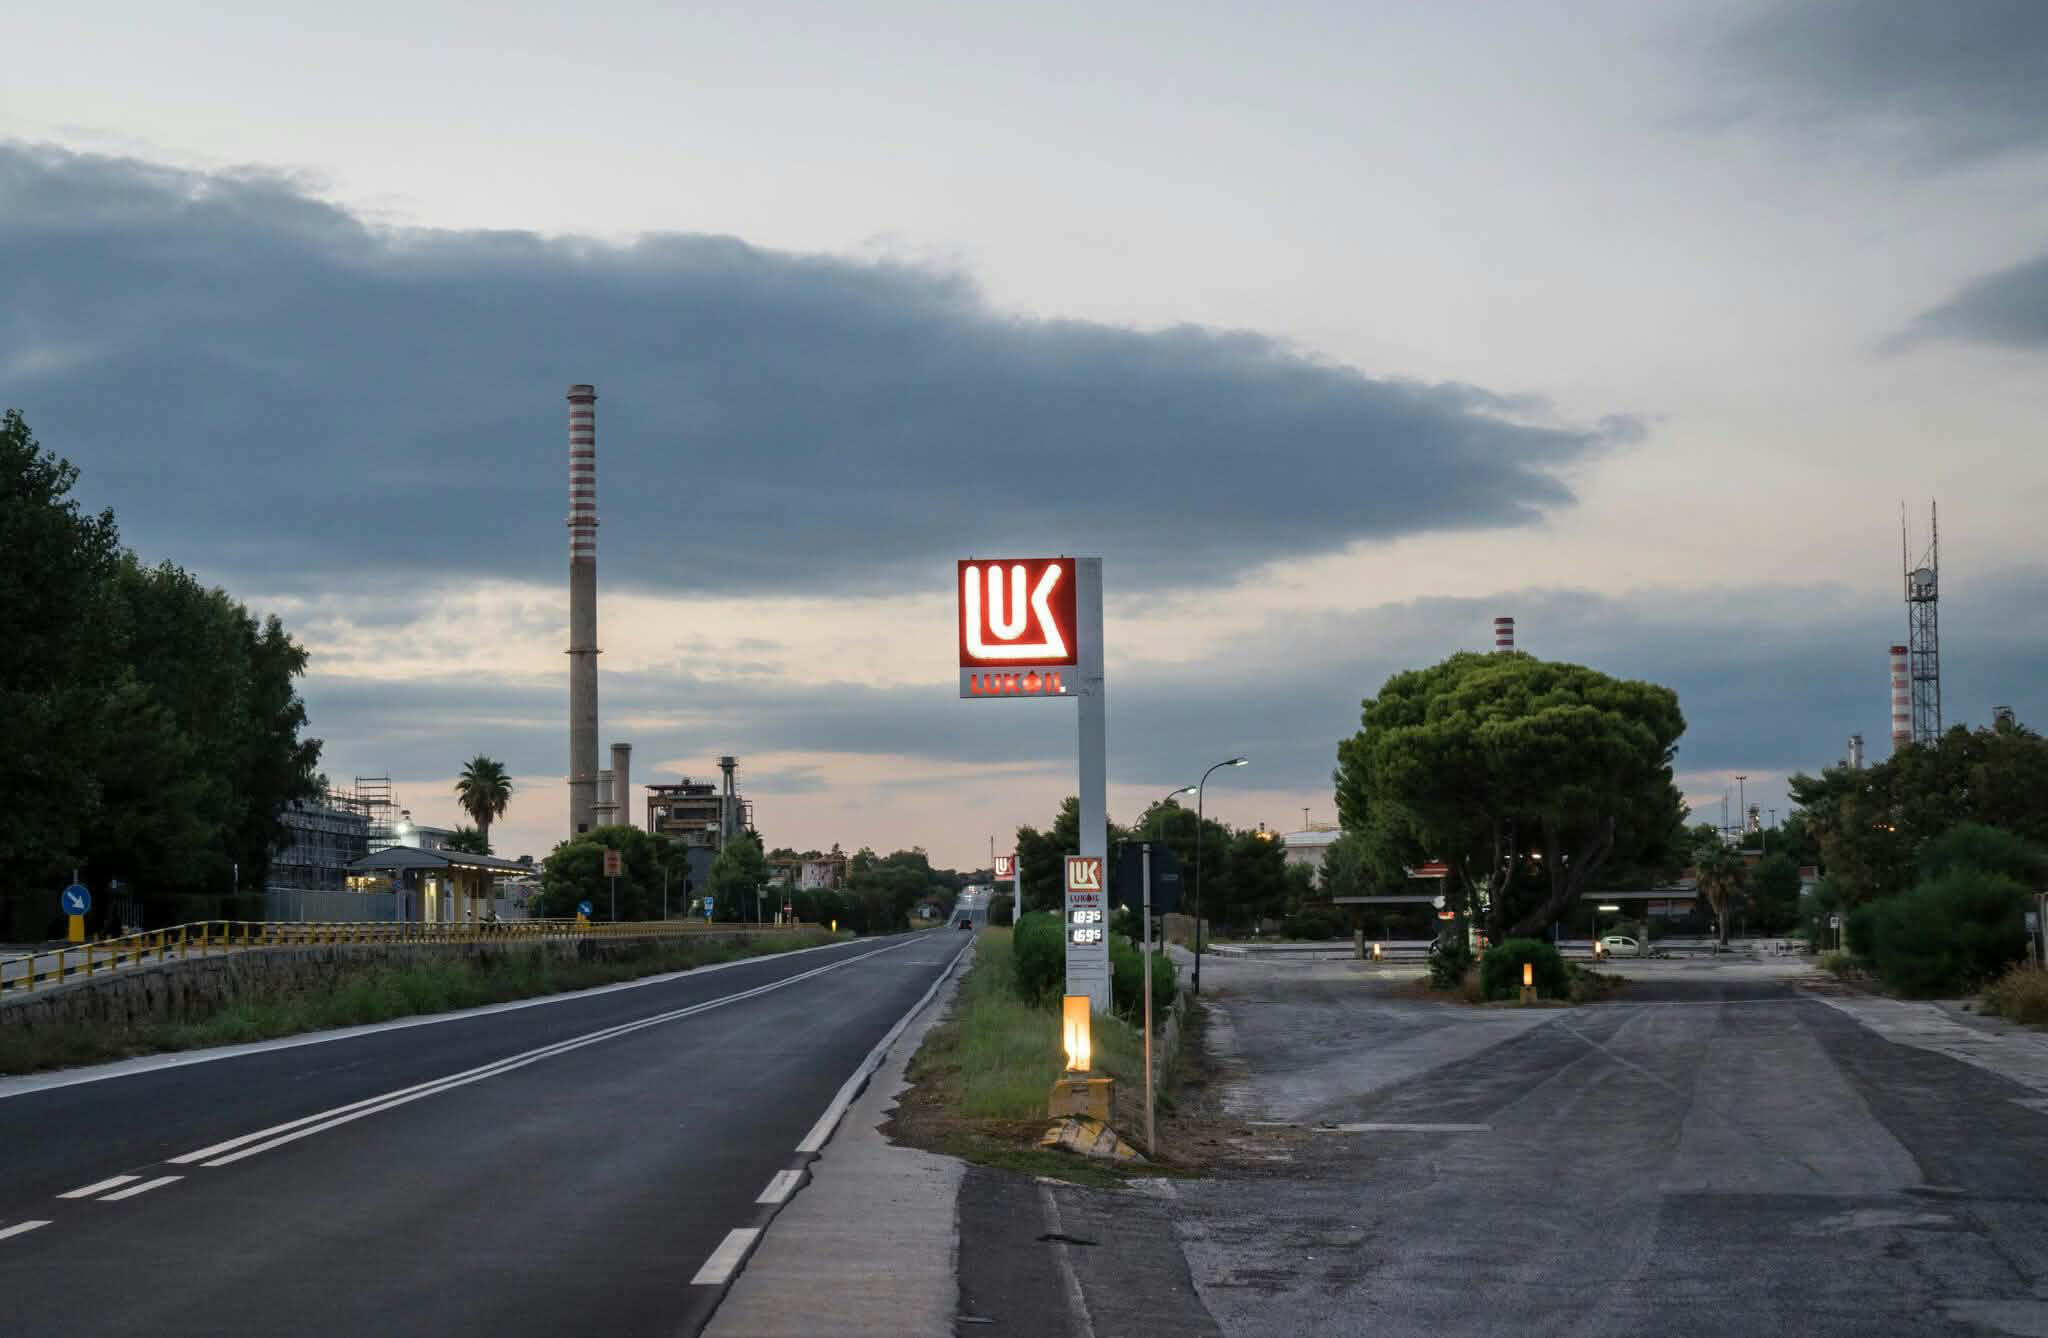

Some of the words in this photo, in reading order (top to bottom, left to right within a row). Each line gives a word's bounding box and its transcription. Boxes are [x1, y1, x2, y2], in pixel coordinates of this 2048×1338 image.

[965, 564, 1069, 659] LUK
[970, 671, 1066, 695] LUKOIL
[1069, 861, 1101, 889] LUK
